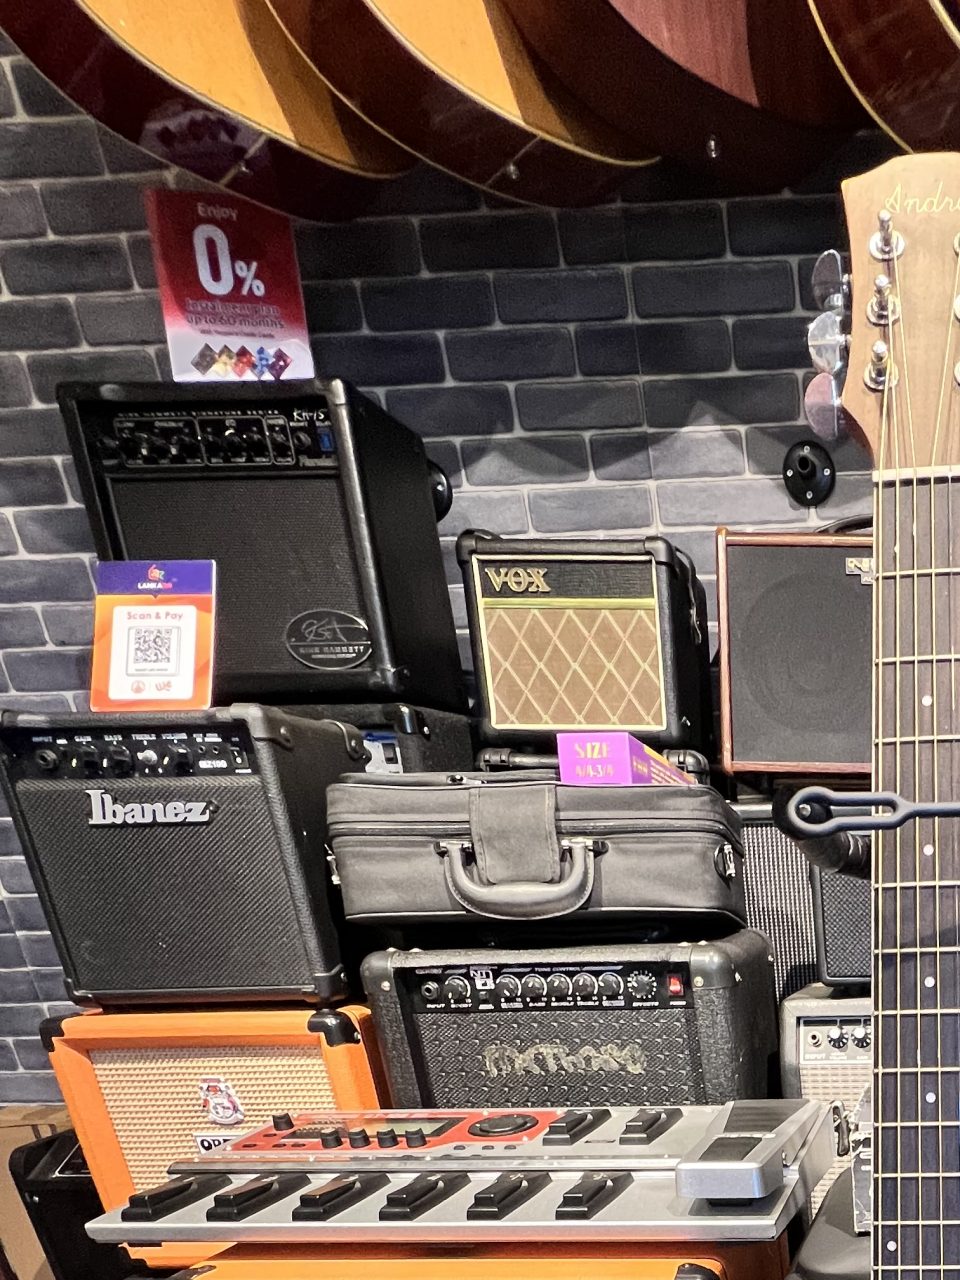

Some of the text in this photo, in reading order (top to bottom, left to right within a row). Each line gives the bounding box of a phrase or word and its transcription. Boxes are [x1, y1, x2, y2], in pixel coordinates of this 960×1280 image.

[197, 203, 239, 221] Enjoy
[193, 224, 266, 297] 0%
[240, 318, 285, 329] months
[485, 567, 551, 592] VOX
[127, 611, 184, 622] Scan & Pay
[575, 742, 610, 759] SIZE
[85, 789, 210, 825] Ibanez
